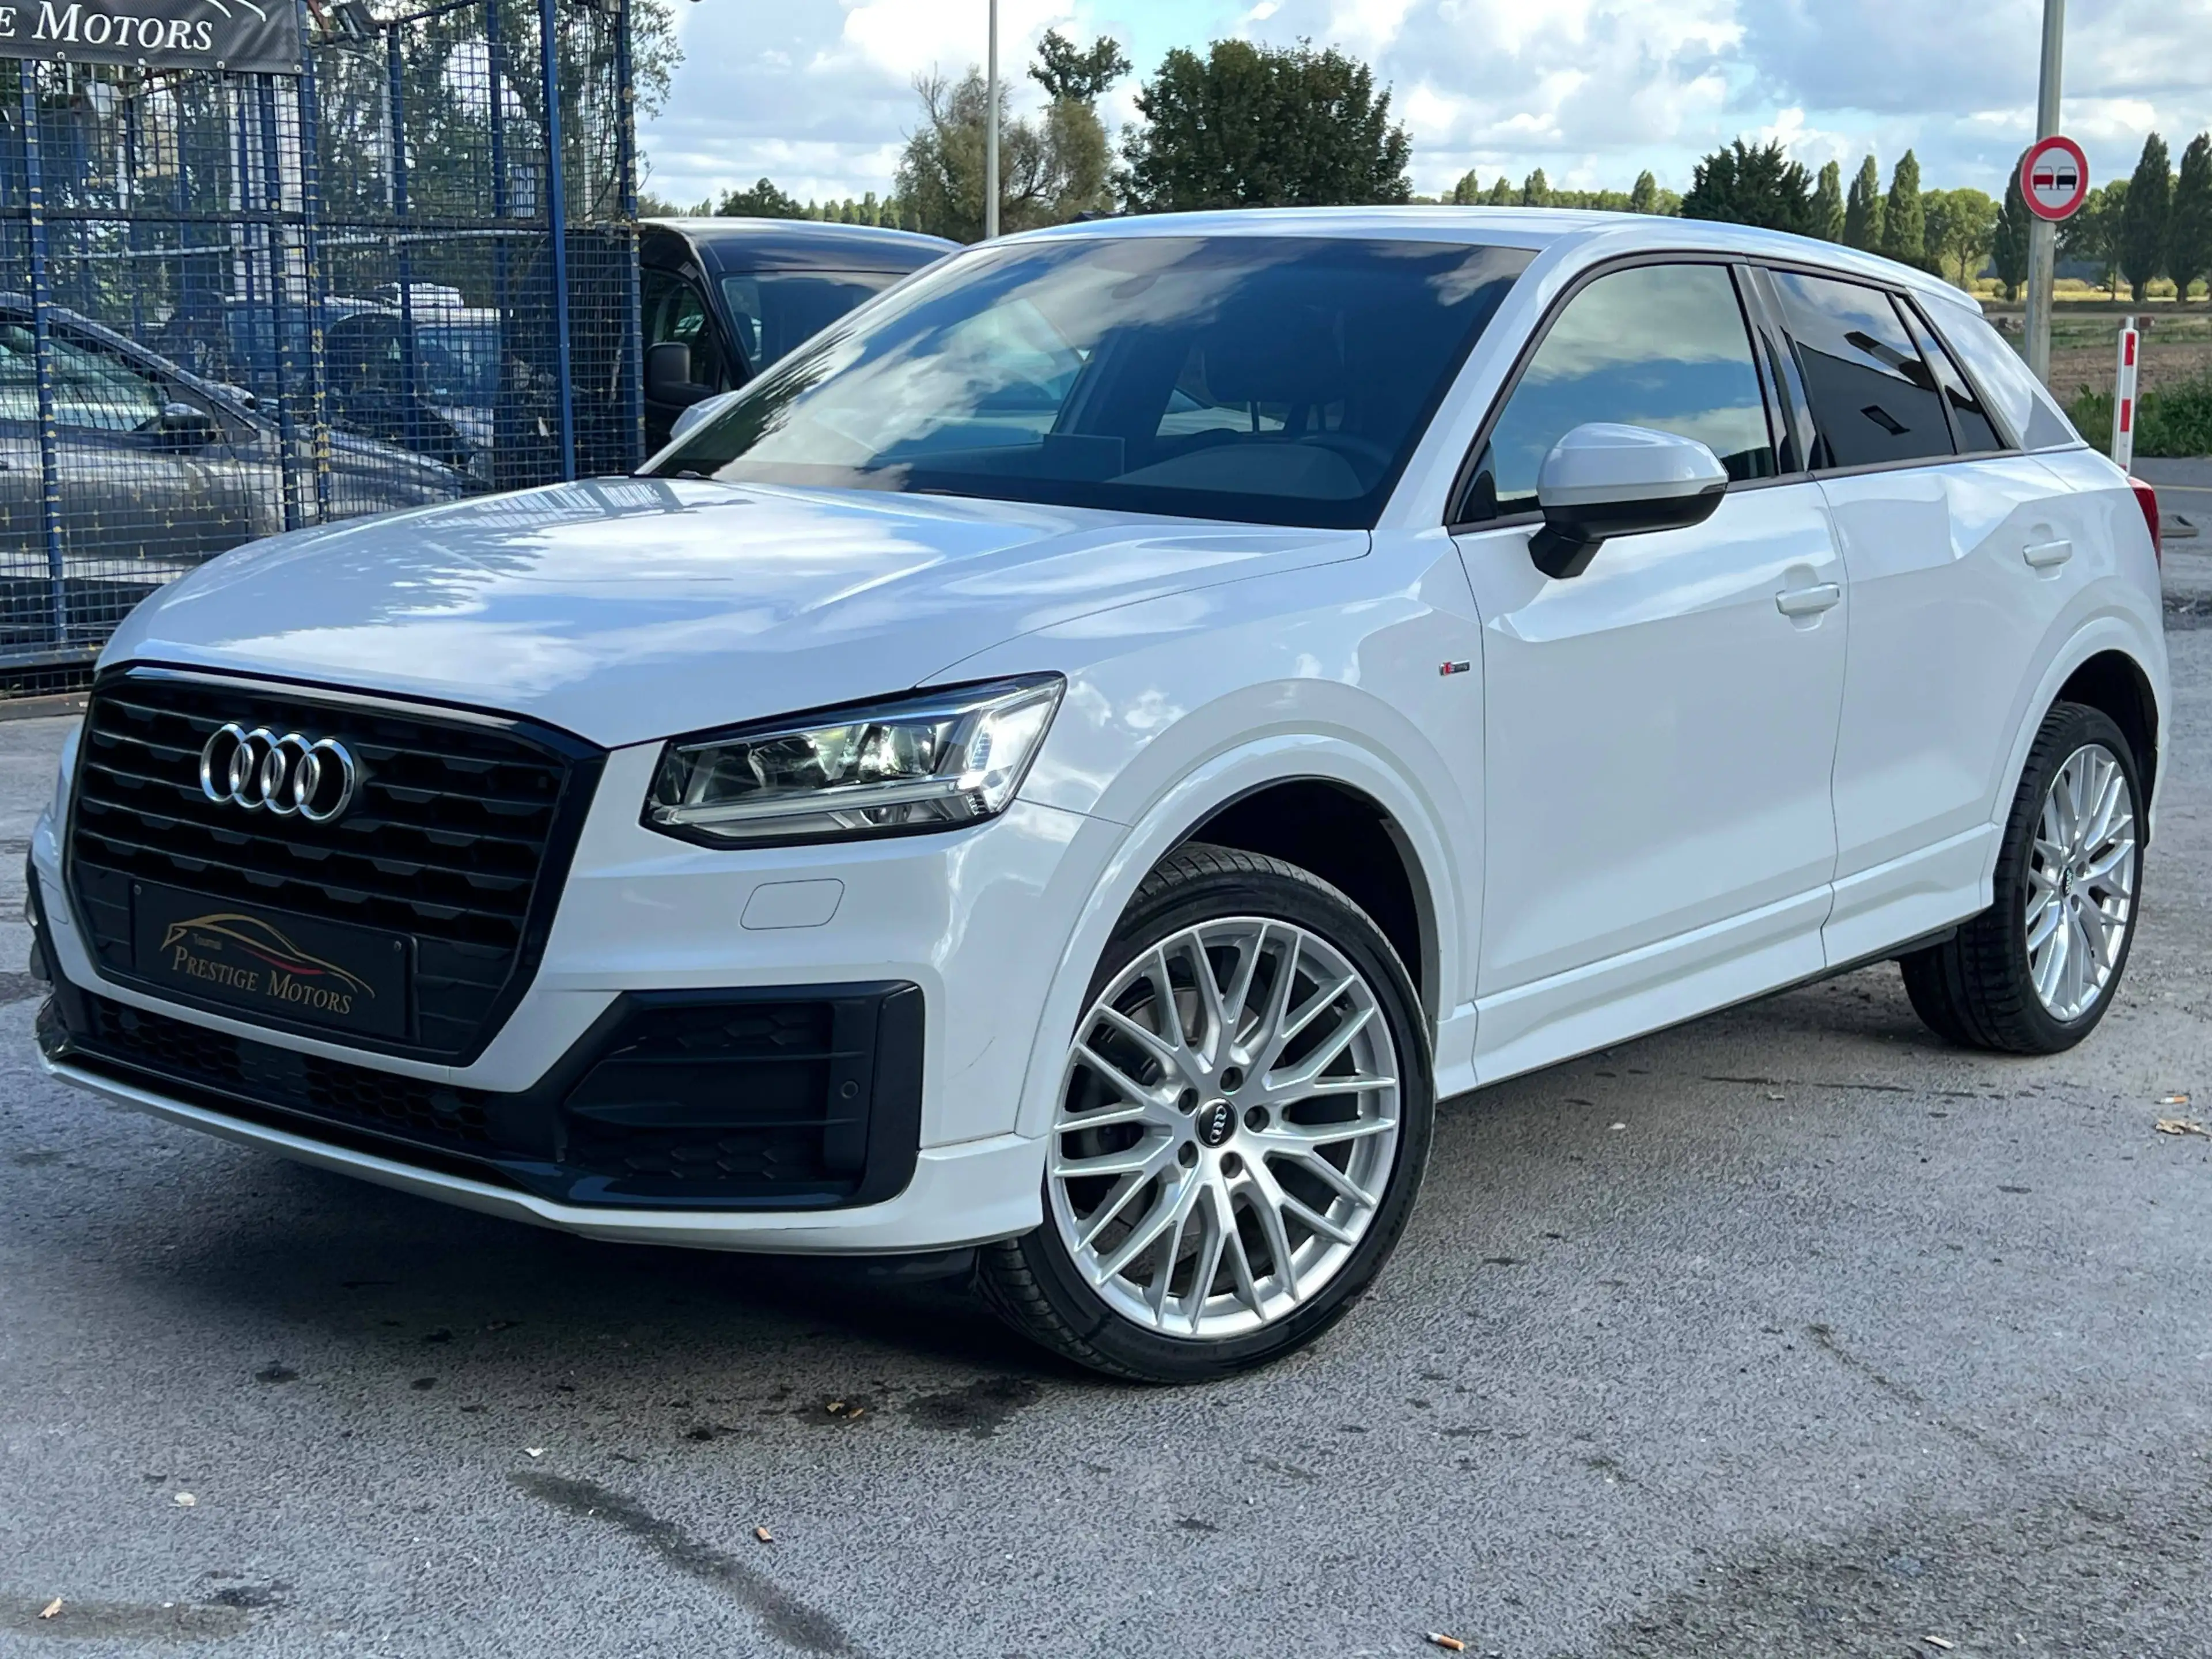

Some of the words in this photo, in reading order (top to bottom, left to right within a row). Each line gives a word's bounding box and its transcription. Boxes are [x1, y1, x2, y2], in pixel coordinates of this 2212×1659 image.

[32, 1, 213, 51] MOTORS
[172, 945, 259, 991] PRESTIGE
[267, 970, 352, 1014] MOTORS
